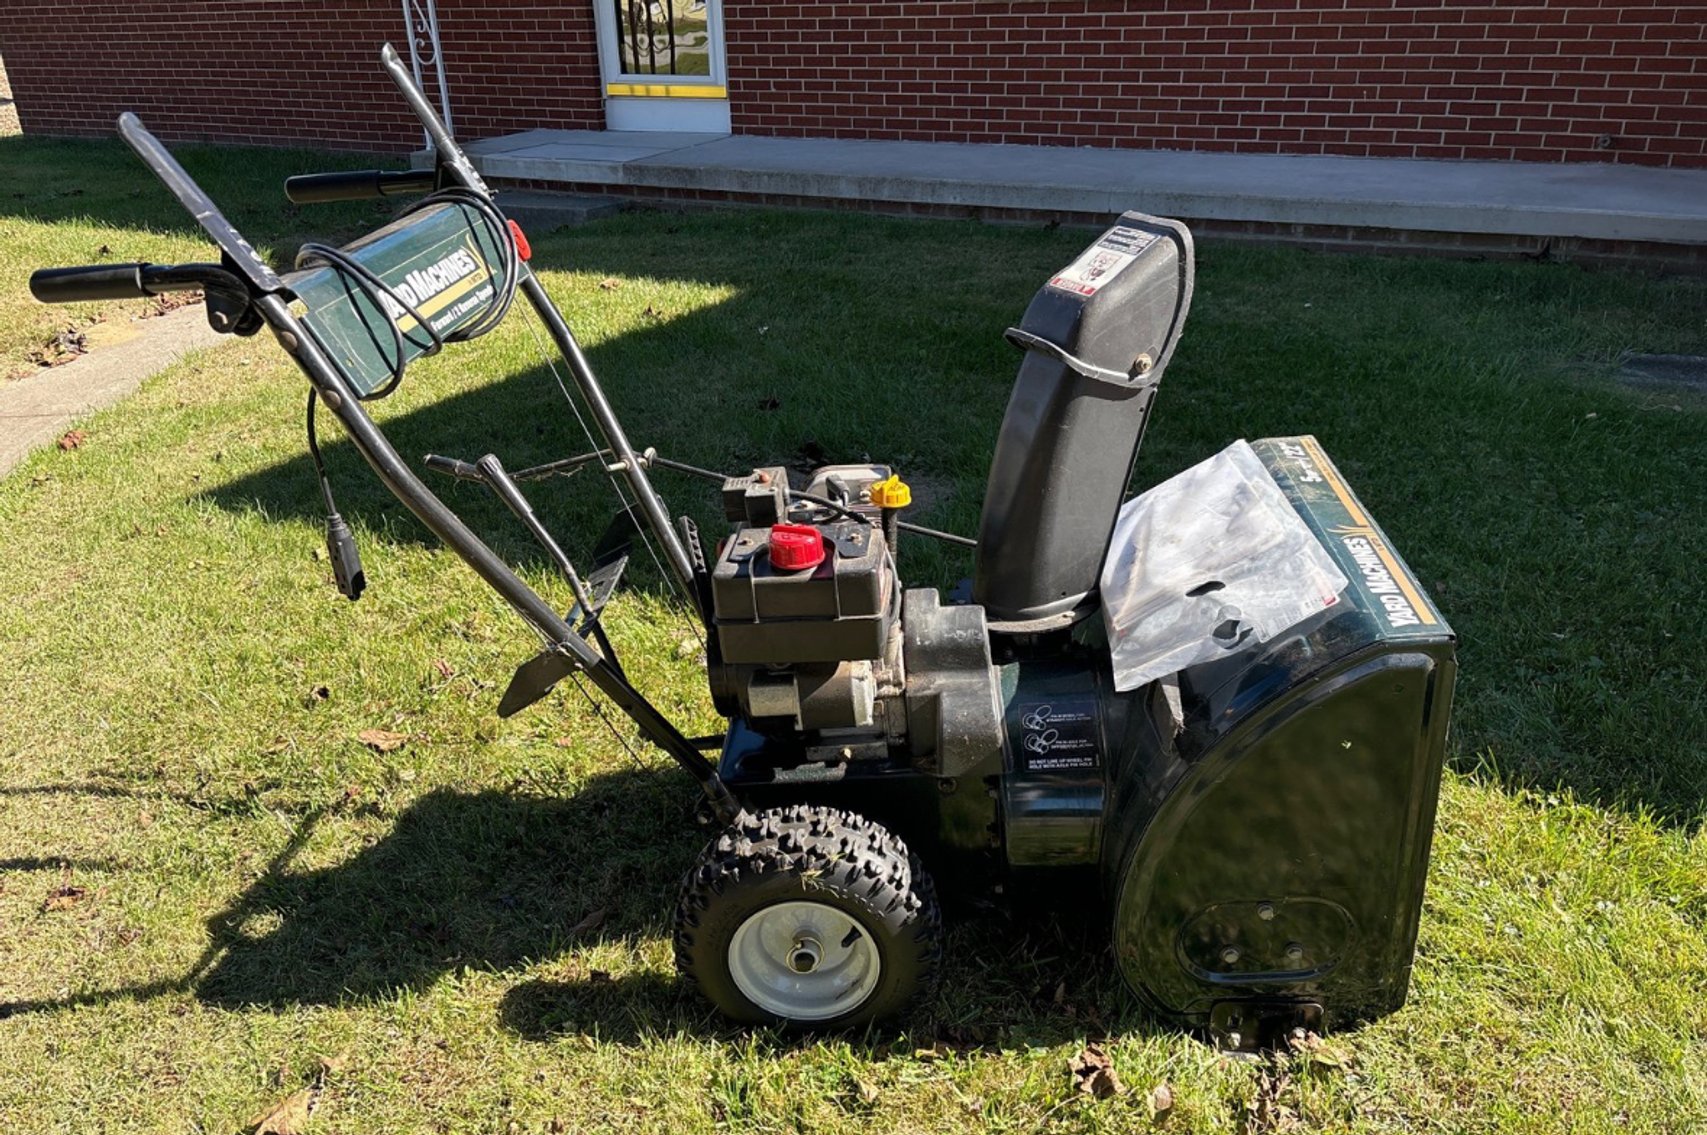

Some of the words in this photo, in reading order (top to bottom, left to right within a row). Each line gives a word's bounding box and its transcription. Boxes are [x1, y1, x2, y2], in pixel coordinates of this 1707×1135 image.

[405, 249, 476, 302] MACHINES
[1343, 537, 1402, 594] MACHINES
[1379, 594, 1421, 628] YARD
